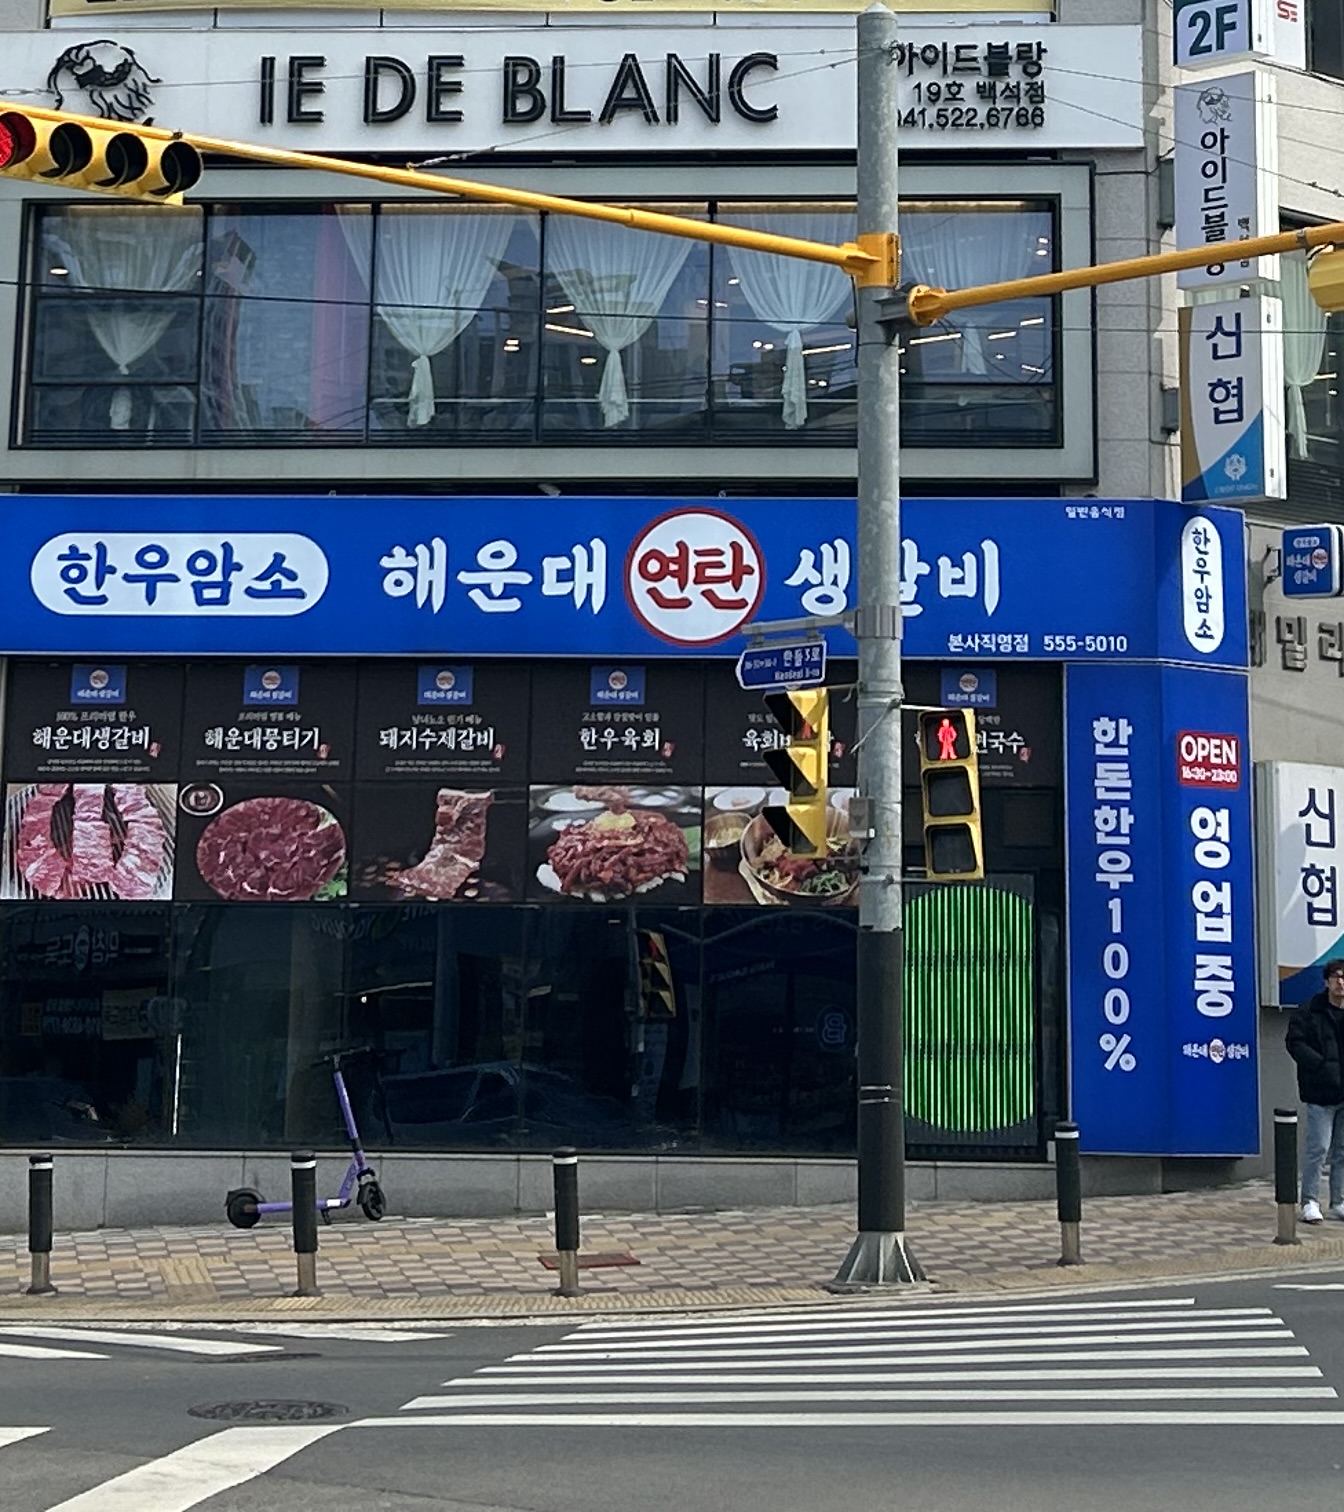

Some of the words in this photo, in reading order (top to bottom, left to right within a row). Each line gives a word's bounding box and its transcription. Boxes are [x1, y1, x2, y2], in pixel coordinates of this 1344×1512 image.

[1187, 3, 1238, 57] 2F
[260, 53, 327, 126] IE
[363, 53, 467, 126] DE
[502, 51, 781, 126] BLANC
[976, 80, 1045, 105] 백석점
[1205, 312, 1244, 425] 신협
[57, 541, 312, 607] 한우암소
[377, 536, 607, 618] 해운대
[637, 540, 755, 610] 연탄
[1192, 527, 1215, 640] 한우암소
[947, 634, 1030, 653] 본사직영점
[1043, 635, 1129, 653] 555-5010
[32, 725, 150, 750] 해운대생갈비
[379, 726, 495, 751] 돼지수제갈비
[579, 727, 660, 751] 한우육회
[1180, 734, 1237, 765] OPEN
[1299, 787, 1338, 928] 신협
[1190, 805, 1236, 1018] 영업중
